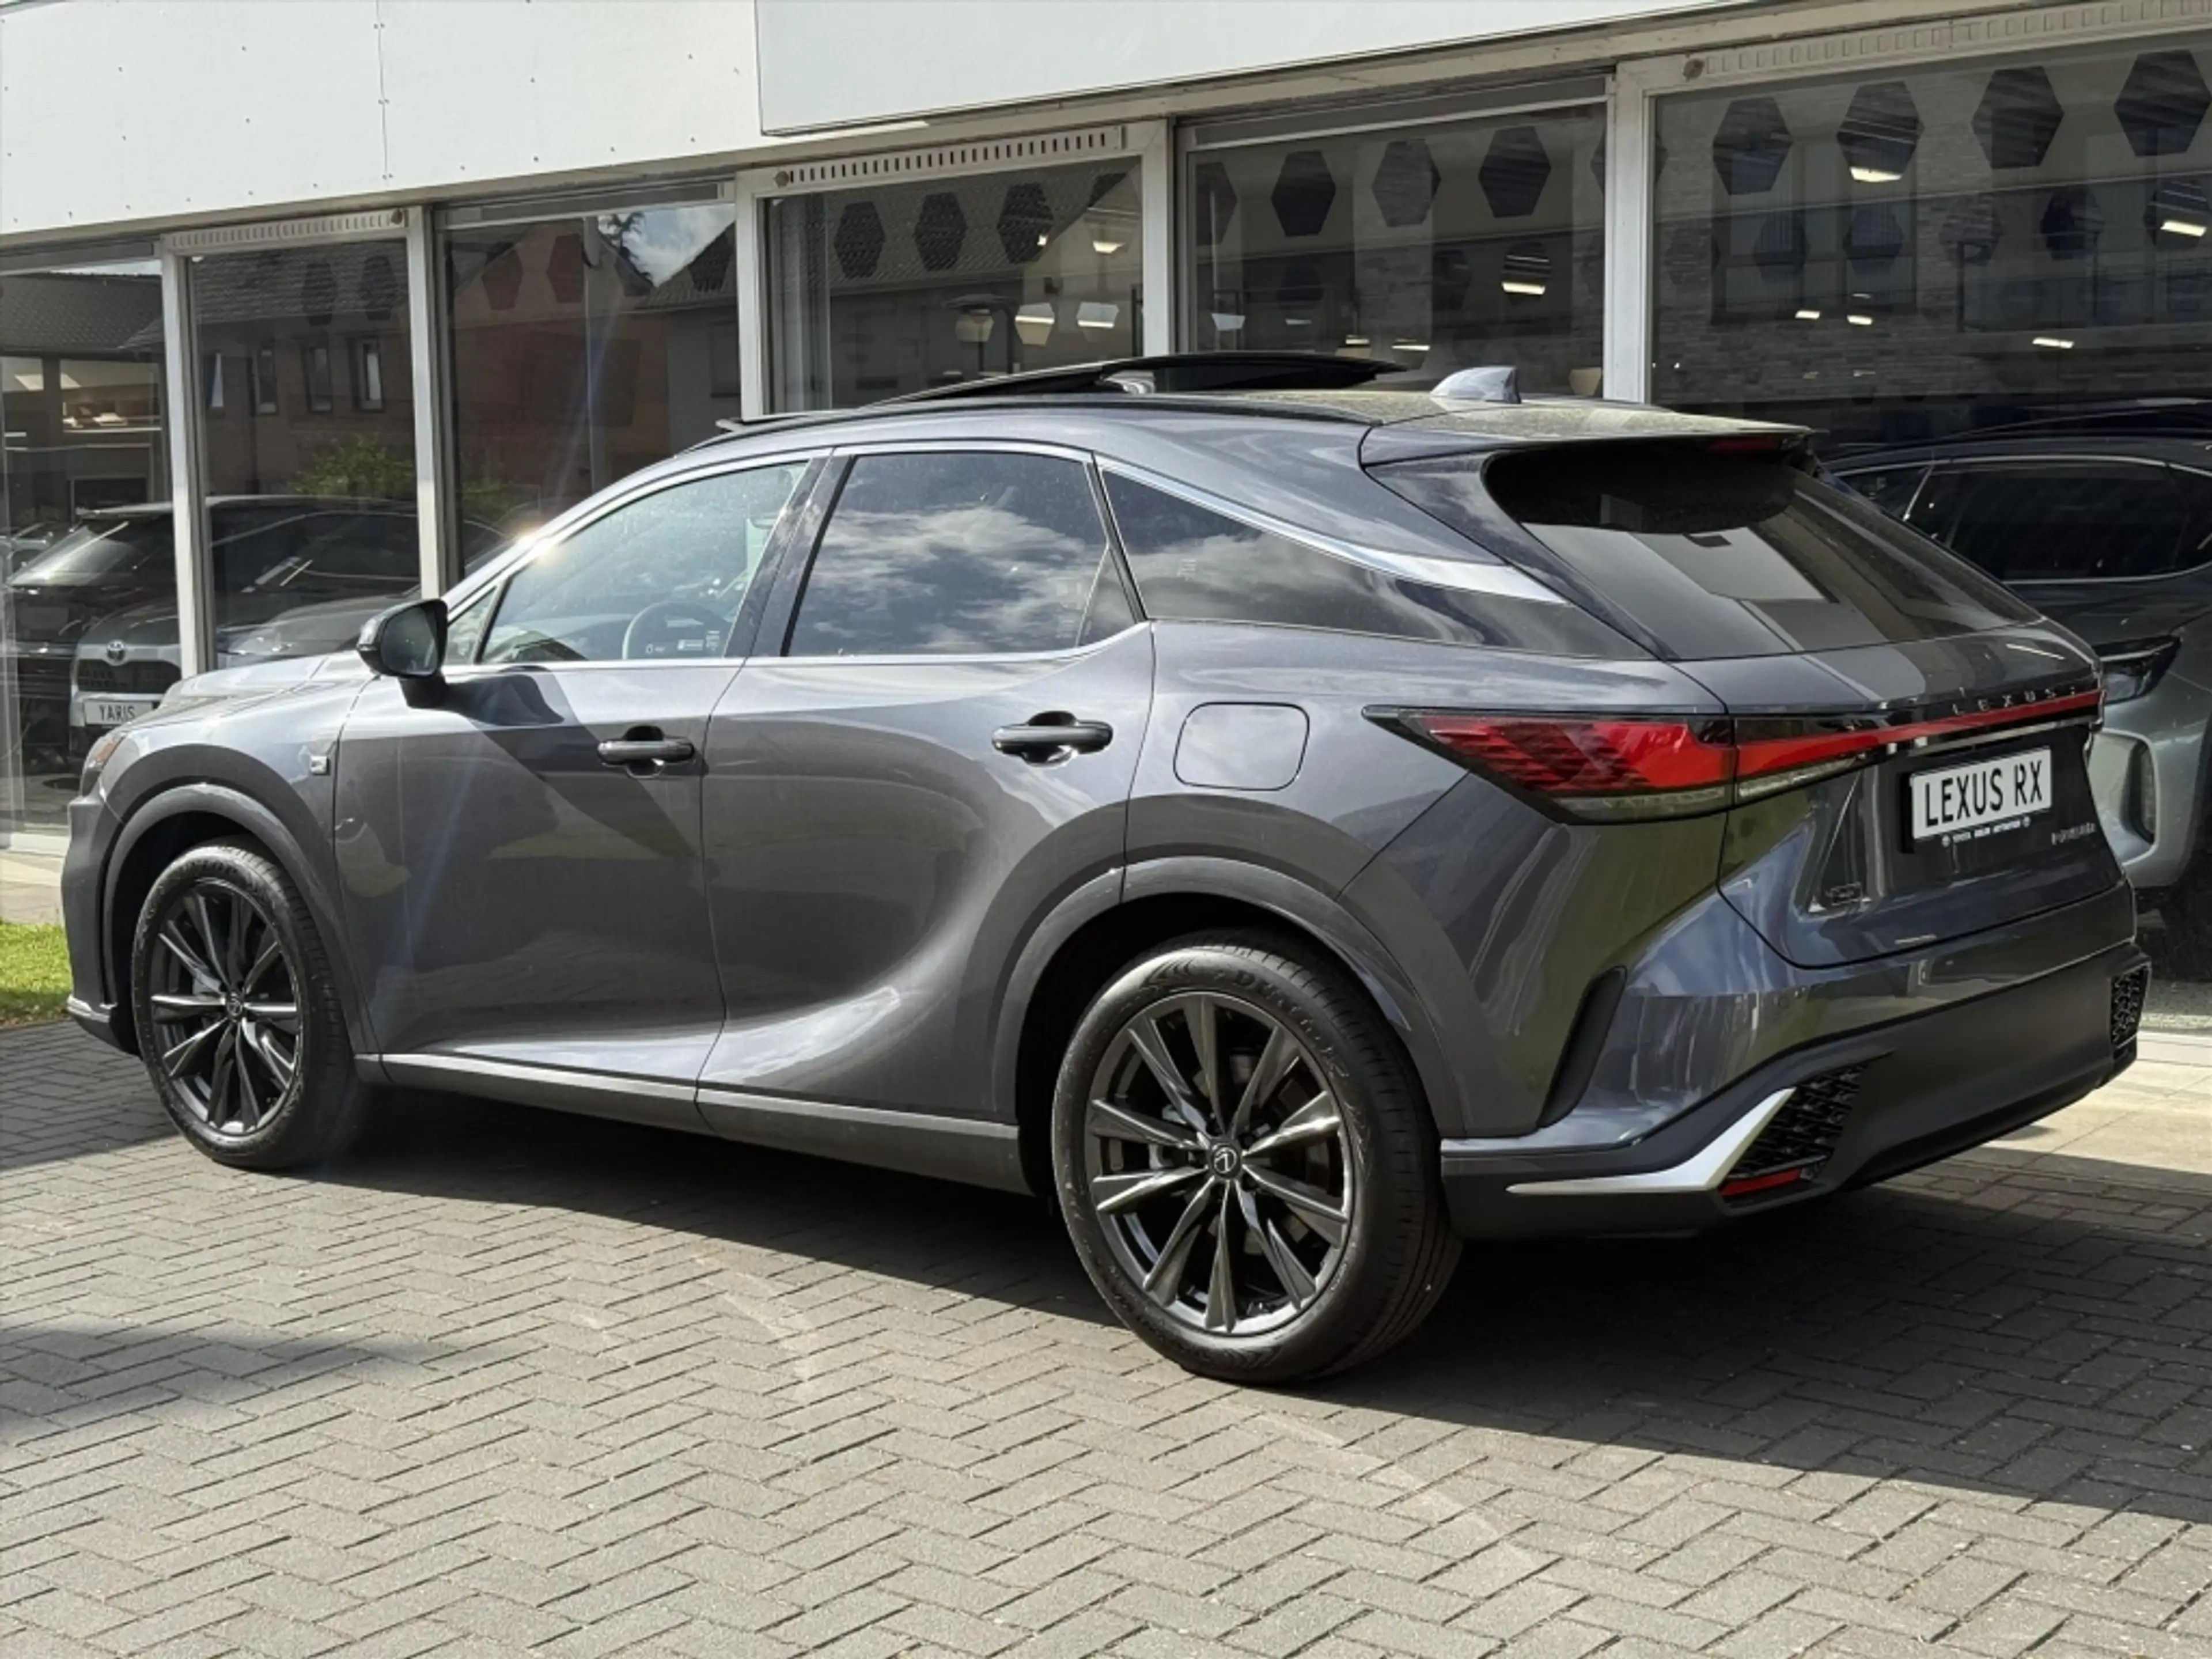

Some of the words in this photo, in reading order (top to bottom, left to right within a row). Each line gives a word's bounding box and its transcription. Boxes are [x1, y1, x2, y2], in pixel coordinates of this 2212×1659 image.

[99, 704, 135, 721] YARIS
[1951, 687, 2058, 716] LEXUS
[1925, 767, 2003, 827] LEXUS
[2014, 759, 2043, 806] RX
